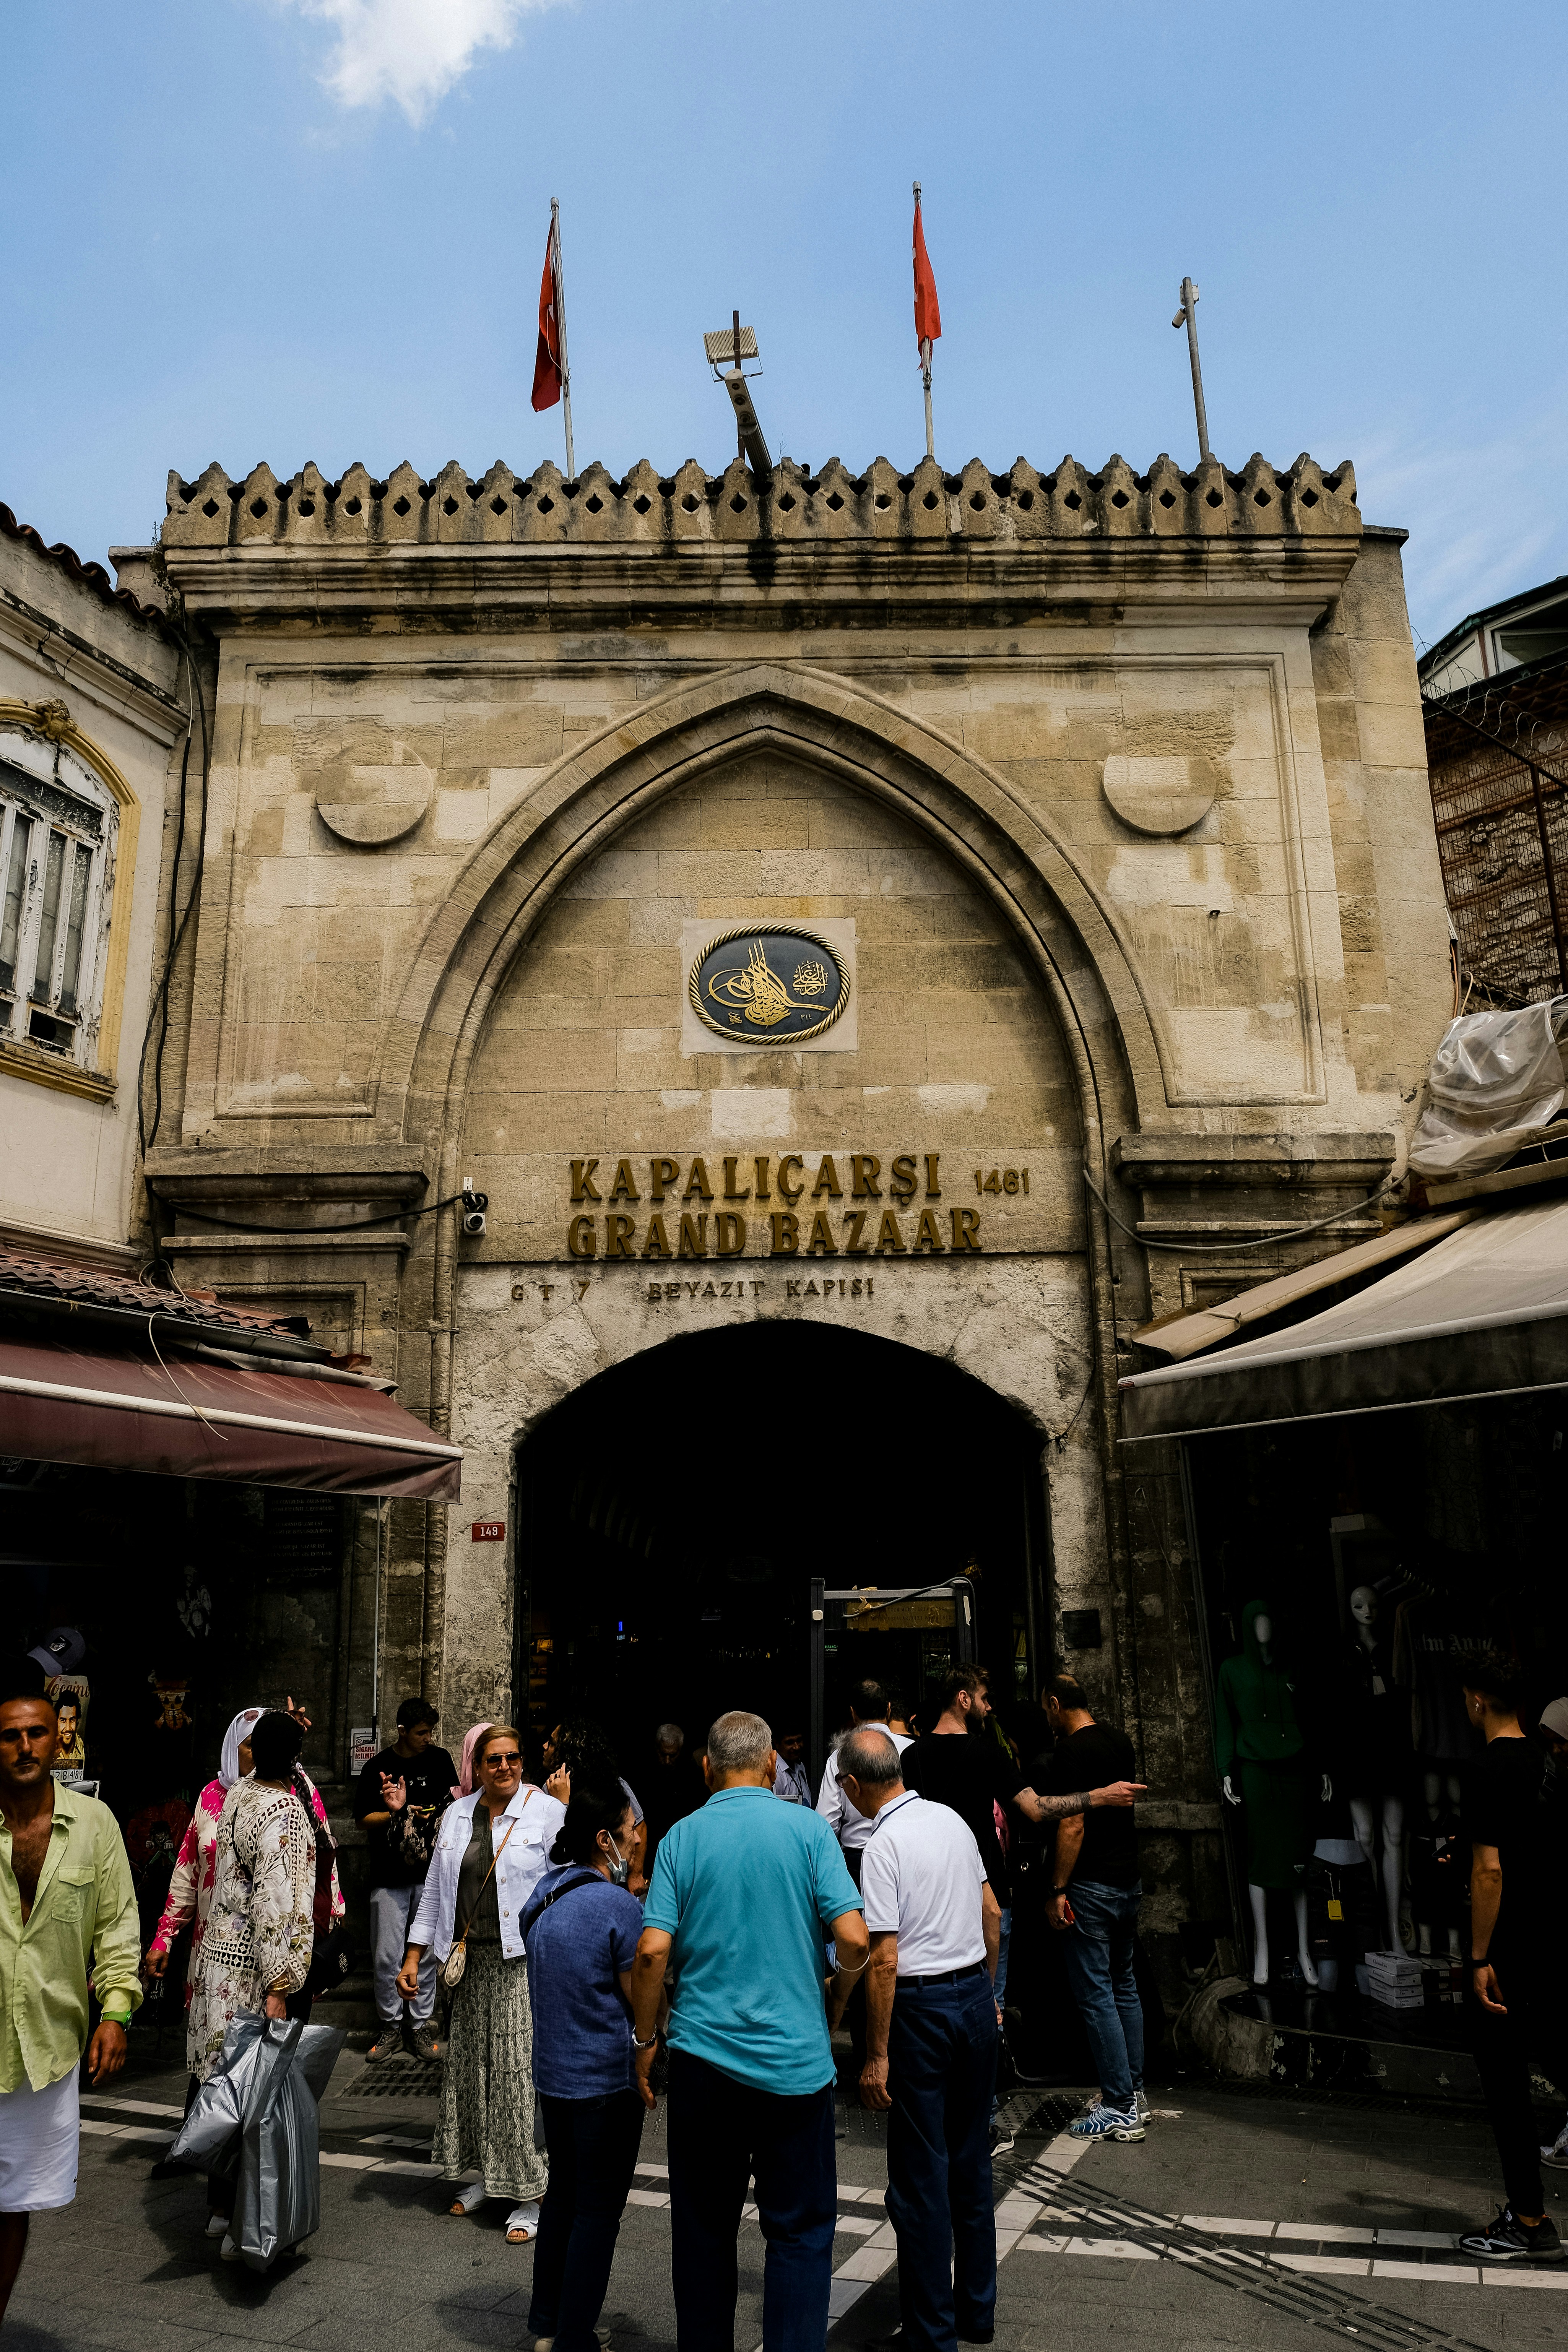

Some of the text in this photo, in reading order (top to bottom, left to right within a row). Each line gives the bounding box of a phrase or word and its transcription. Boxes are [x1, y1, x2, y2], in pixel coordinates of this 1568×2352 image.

[570, 1153, 1029, 1204] KAPALIÇARŞI 1461
[569, 1207, 982, 1256] GRAND BAZAAR
[578, 1281, 590, 1300] 7
[650, 1278, 874, 1298] BEYAZIT KAPISI
[480, 1526, 498, 1536] 149
[45, 1676, 89, 1697] Cocaine
